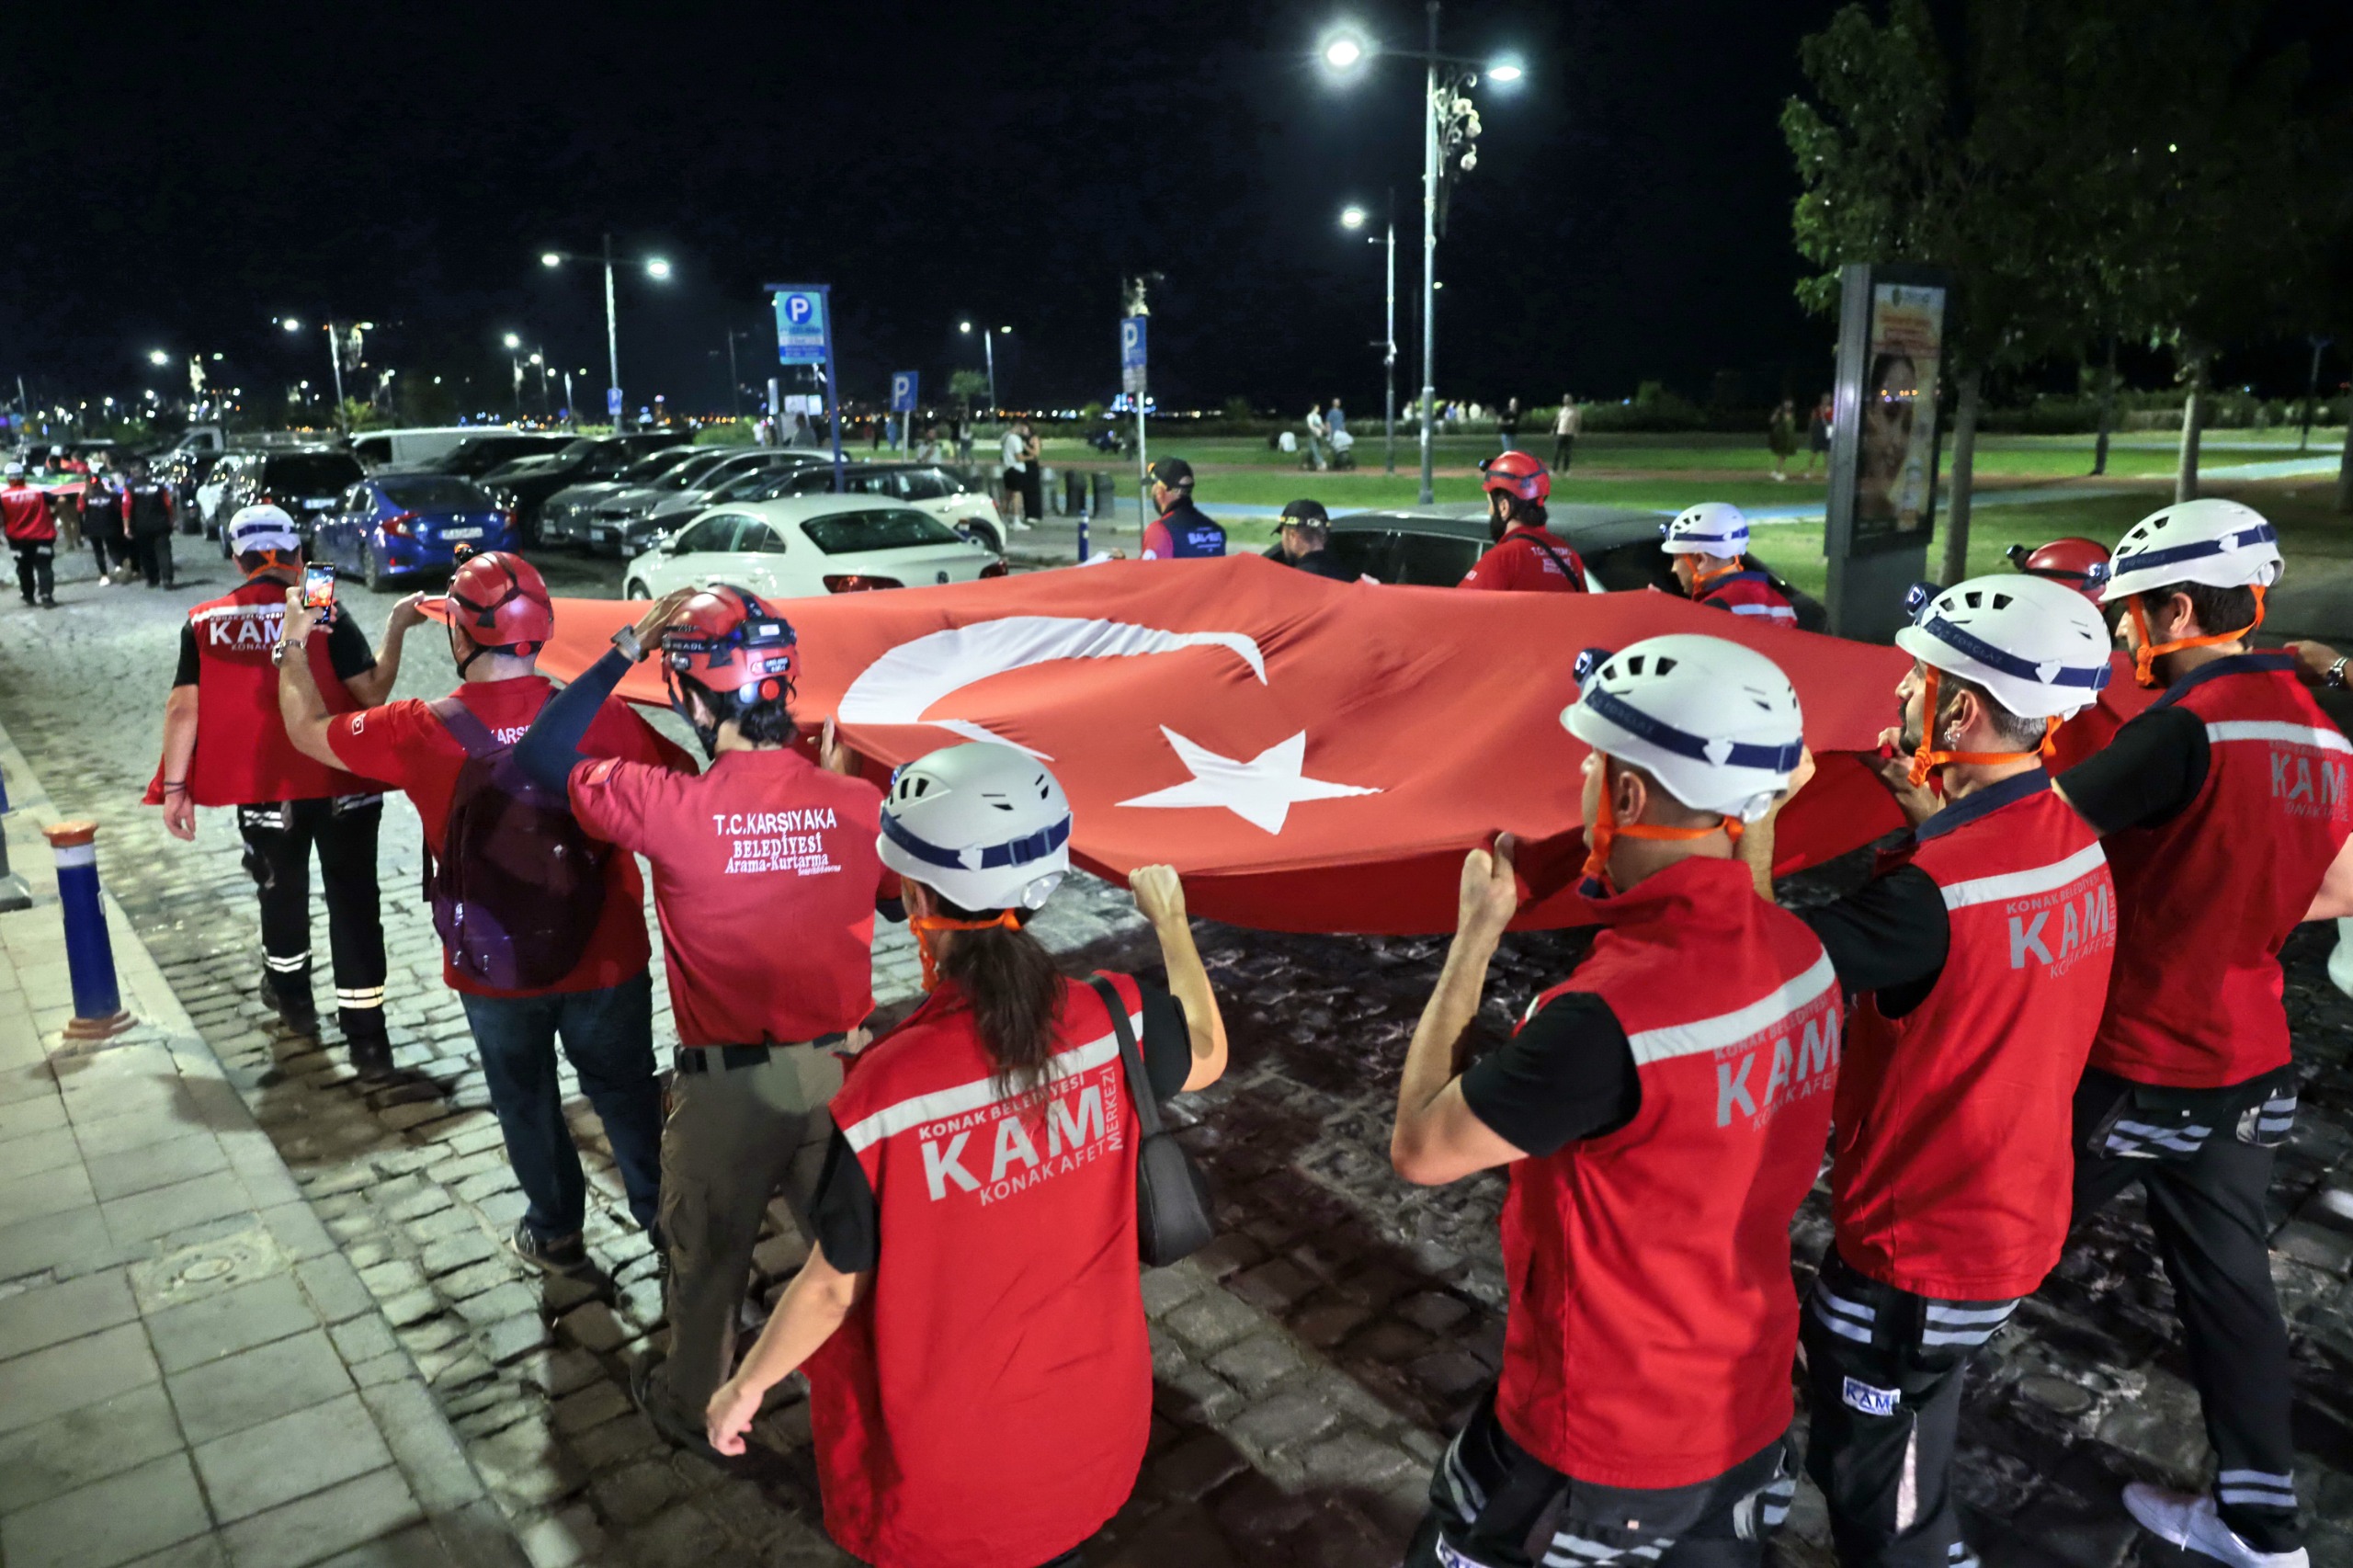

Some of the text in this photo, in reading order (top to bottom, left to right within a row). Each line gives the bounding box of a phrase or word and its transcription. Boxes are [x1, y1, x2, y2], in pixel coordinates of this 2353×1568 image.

[791, 298, 809, 322] P
[1123, 323, 1138, 362] P
[895, 376, 909, 407] P
[2270, 752, 2347, 806] KAM
[725, 853, 828, 873] Arama-Kurtarma
[733, 831, 824, 858] BELEDİYESİ
[2006, 892, 2059, 915] KONAK
[2008, 883, 2109, 969] KAM
[1717, 1007, 1839, 1128] KAM
[919, 1110, 986, 1140] KONAK
[1100, 1066, 1123, 1151] MERKEZİ
[921, 1085, 1104, 1201] KAM
[980, 1139, 1106, 1206] KONAK AFET
